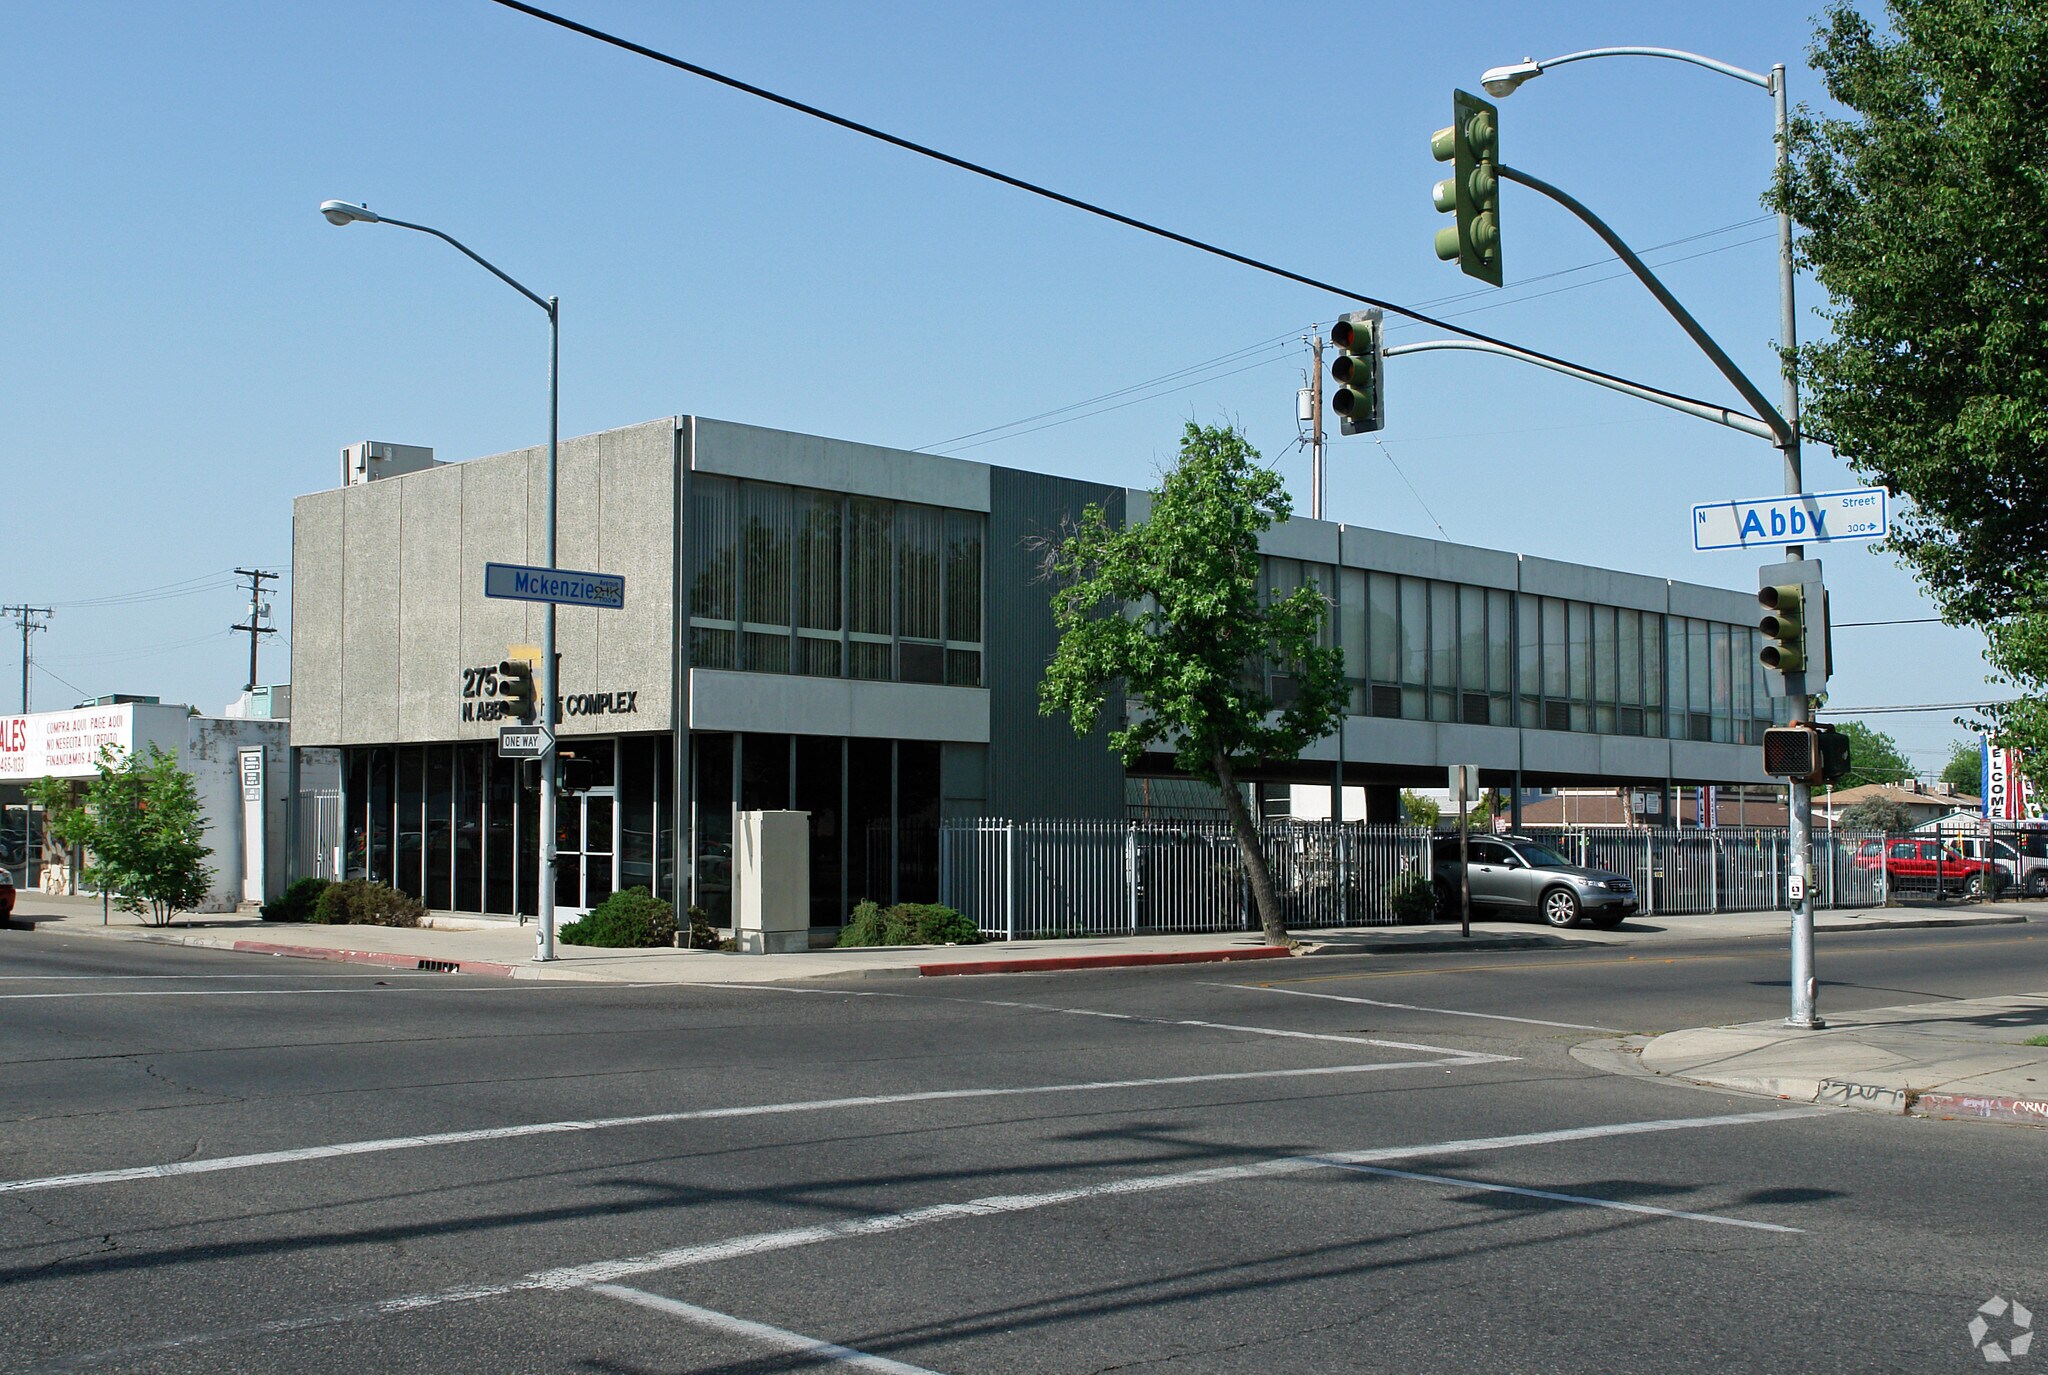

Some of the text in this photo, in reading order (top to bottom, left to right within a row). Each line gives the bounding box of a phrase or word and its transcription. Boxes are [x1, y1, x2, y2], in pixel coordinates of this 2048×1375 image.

[1698, 495, 1876, 540] N Abby Street
[1847, 523, 1866, 533] 300
[515, 571, 595, 600] Mckenzie
[463, 666, 498, 699] 275
[463, 702, 474, 722] N.
[475, 700, 503, 722] ABB
[566, 690, 638, 717] COMPLEX
[46, 714, 123, 735] COMPRA AQUI PAGE AQUI
[46, 738, 55, 751] NO
[83, 734, 92, 747] TU
[504, 734, 538, 748] ONE WAY
[1990, 747, 2005, 818] ELCOME
